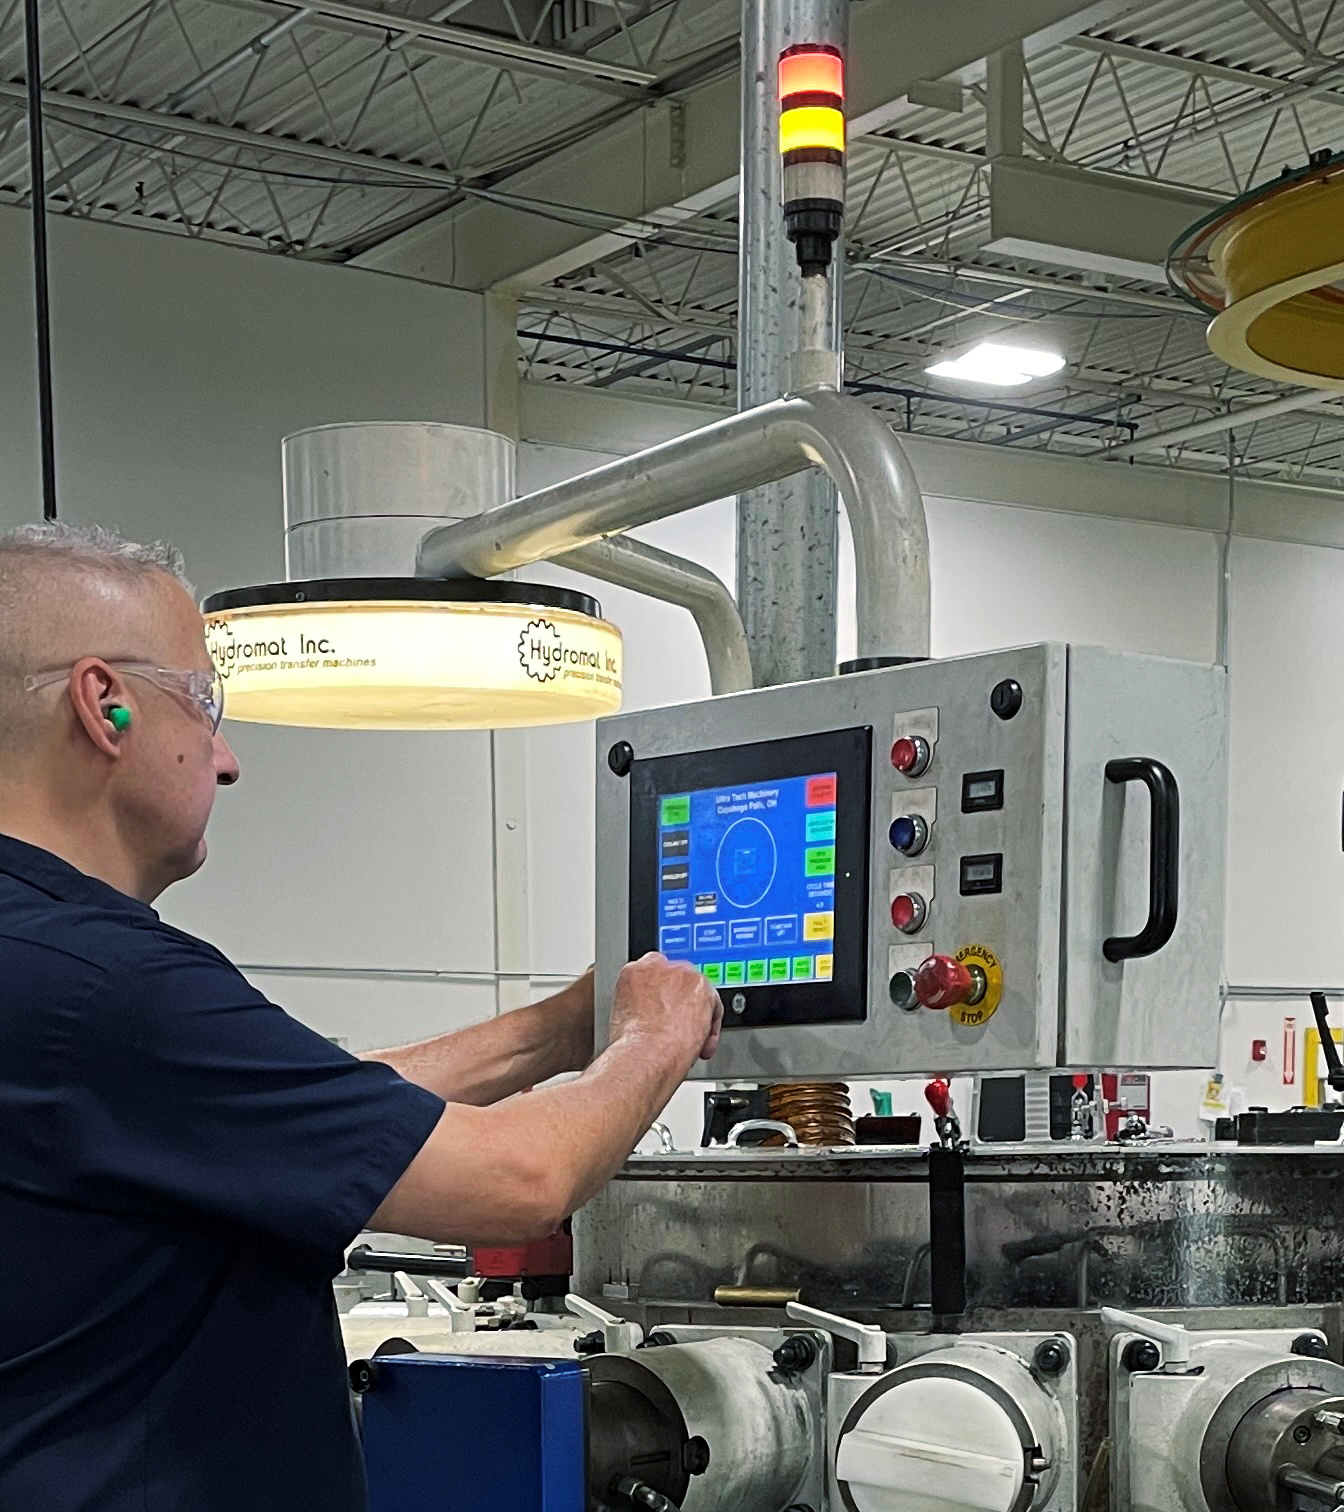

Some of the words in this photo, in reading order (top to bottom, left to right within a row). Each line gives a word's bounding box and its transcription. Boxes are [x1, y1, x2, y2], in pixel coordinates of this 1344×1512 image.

[211, 637, 288, 667] Hydromat
[300, 633, 336, 654] Inc.
[530, 638, 601, 669] Hydromat
[237, 660, 278, 675] precision
[280, 656, 320, 669] transfer
[322, 657, 377, 668] machines
[960, 1010, 984, 1024] STOP
